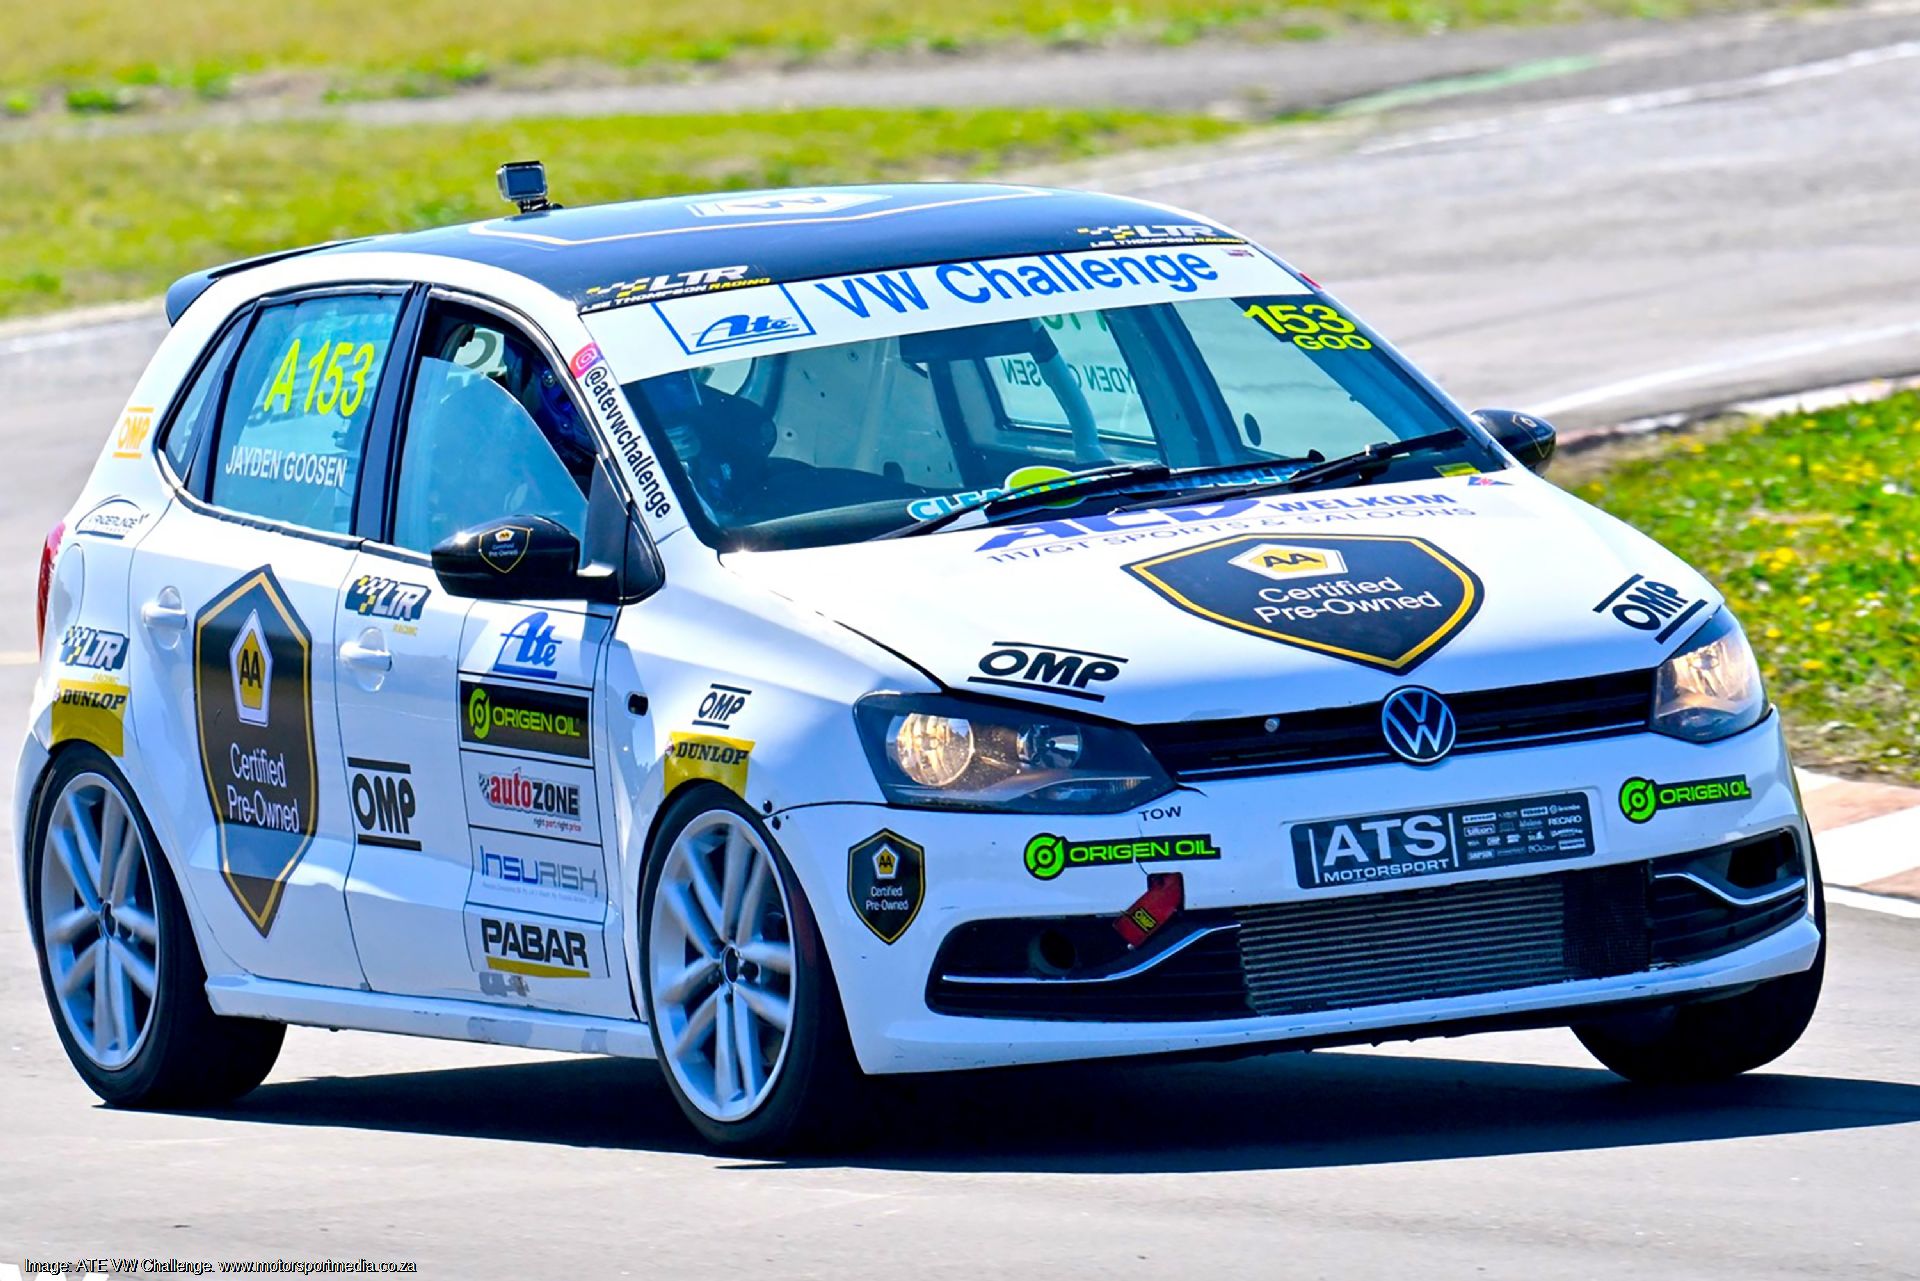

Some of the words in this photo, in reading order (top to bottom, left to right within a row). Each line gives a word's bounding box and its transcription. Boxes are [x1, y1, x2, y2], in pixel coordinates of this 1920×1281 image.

[1134, 225, 1217, 237] LTR
[614, 284, 706, 306] THOMPSON
[649, 265, 748, 292] LTR
[815, 271, 929, 318] VW
[935, 252, 1218, 303] Challenge
[694, 314, 794, 347] Ate
[1243, 304, 1357, 335] 153
[1292, 334, 1372, 351] GOO
[264, 339, 300, 412] A
[304, 340, 374, 416] 153
[116, 416, 151, 450] OMP
[584, 366, 671, 519] @atevwchallenge
[225, 445, 282, 480] JAYDEN
[283, 451, 348, 488] GOOSEN
[1266, 494, 1459, 513] WELKOM
[1103, 521, 1249, 546] SPORTS
[1297, 507, 1476, 523] SALOONS
[1263, 552, 1322, 568] AA
[372, 580, 426, 621] LTR
[1258, 577, 1403, 603] Certified
[1612, 581, 1688, 630] OMP
[1253, 591, 1442, 624] Pre-Owned
[76, 630, 124, 670] LTR
[496, 611, 563, 670] Ate
[240, 650, 263, 689] AA
[979, 649, 1120, 689] OMP
[61, 689, 127, 709] DUNLOP
[698, 691, 746, 721] OMP
[492, 706, 552, 733] ORIGEN
[554, 715, 580, 737] OIL
[230, 742, 287, 788] Certified
[676, 741, 751, 765] DUNLOP
[226, 785, 300, 833] Pre-Owned
[352, 773, 416, 834] OMP
[1659, 781, 1729, 805] ORIGEN
[1138, 806, 1182, 822] TOW
[1069, 841, 1169, 862] ORIGEN
[1175, 839, 1215, 856] OIL
[1322, 814, 1447, 867] ATS
[1324, 857, 1450, 883] MOTORSPORT
[865, 899, 909, 911] Pre-Owned
[870, 886, 903, 898] Certified
[481, 918, 589, 969] PABAR
